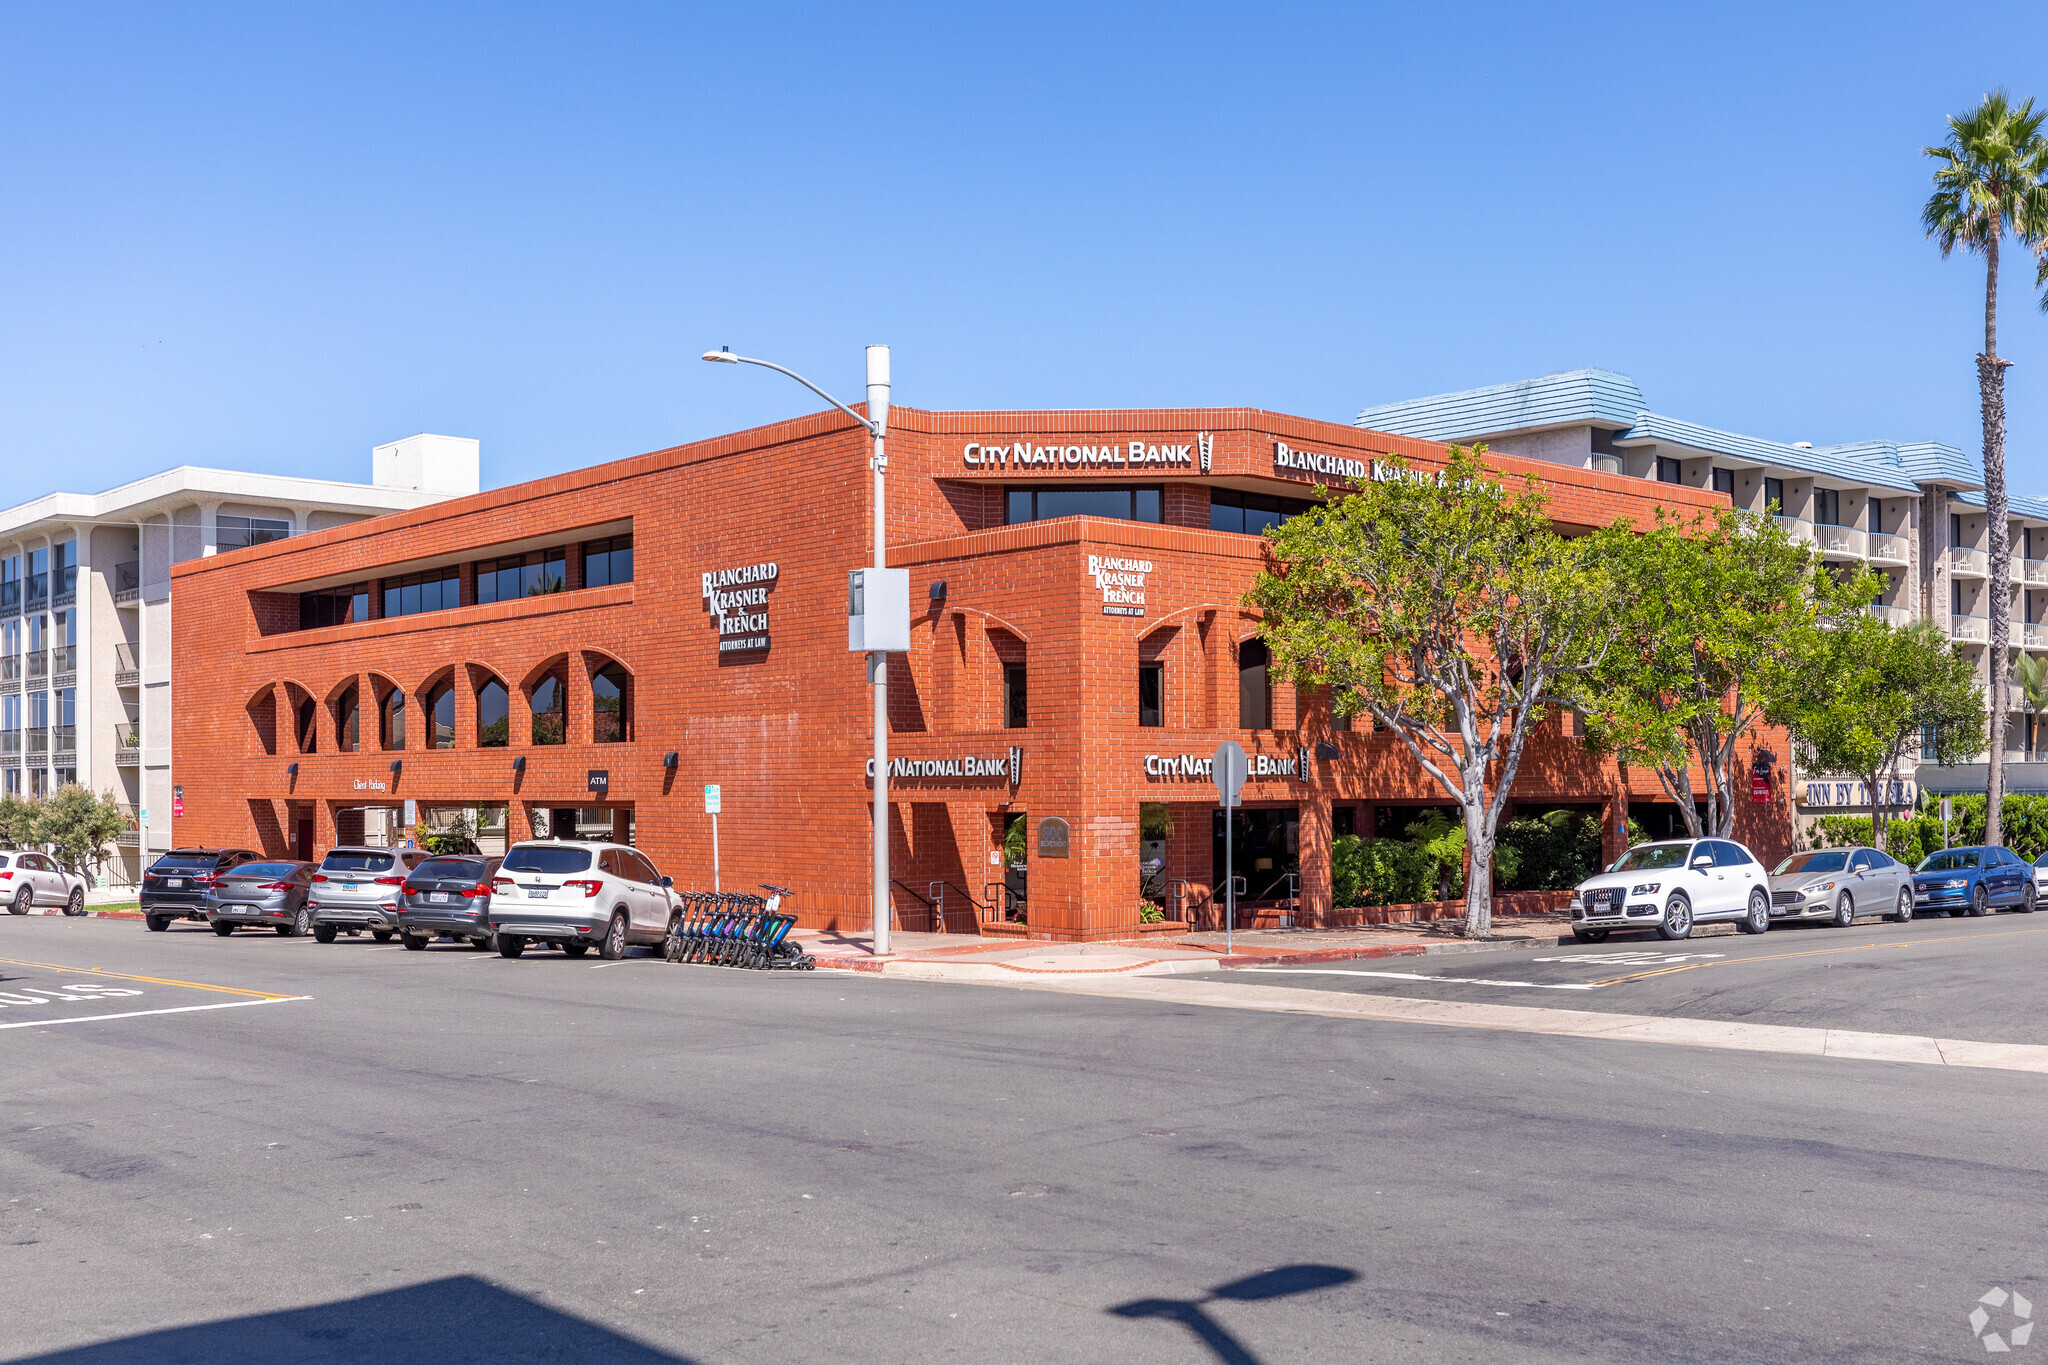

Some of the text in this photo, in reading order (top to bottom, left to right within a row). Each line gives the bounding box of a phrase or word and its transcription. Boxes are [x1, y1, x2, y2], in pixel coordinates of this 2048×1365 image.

[964, 441, 1192, 463] CITY NATIONAL BANK
[1088, 555, 1153, 576] BLANCHARD
[702, 562, 778, 598] BLANCHARD
[1096, 569, 1145, 590] KRASNER
[710, 588, 768, 616] KRASNER
[1103, 586, 1145, 605] FRENCH
[738, 607, 750, 616] &
[1103, 606, 1144, 616] ATTORNEYS AT LAW
[719, 609, 768, 635] FRENCH
[719, 637, 766, 651] ATTORNEYS AT LAW
[866, 756, 1007, 777] CY NATIONAL BANK
[1146, 754, 1297, 775] CITY NATL BANK
[353, 778, 386, 793] Client Parking
[590, 777, 607, 785] ATM
[1807, 783, 1831, 805] INN
[1836, 783, 1854, 805] BY
[1890, 781, 1914, 805] SEA
[1042, 826, 1064, 840] 800
[0, 984, 144, 1008] STO
